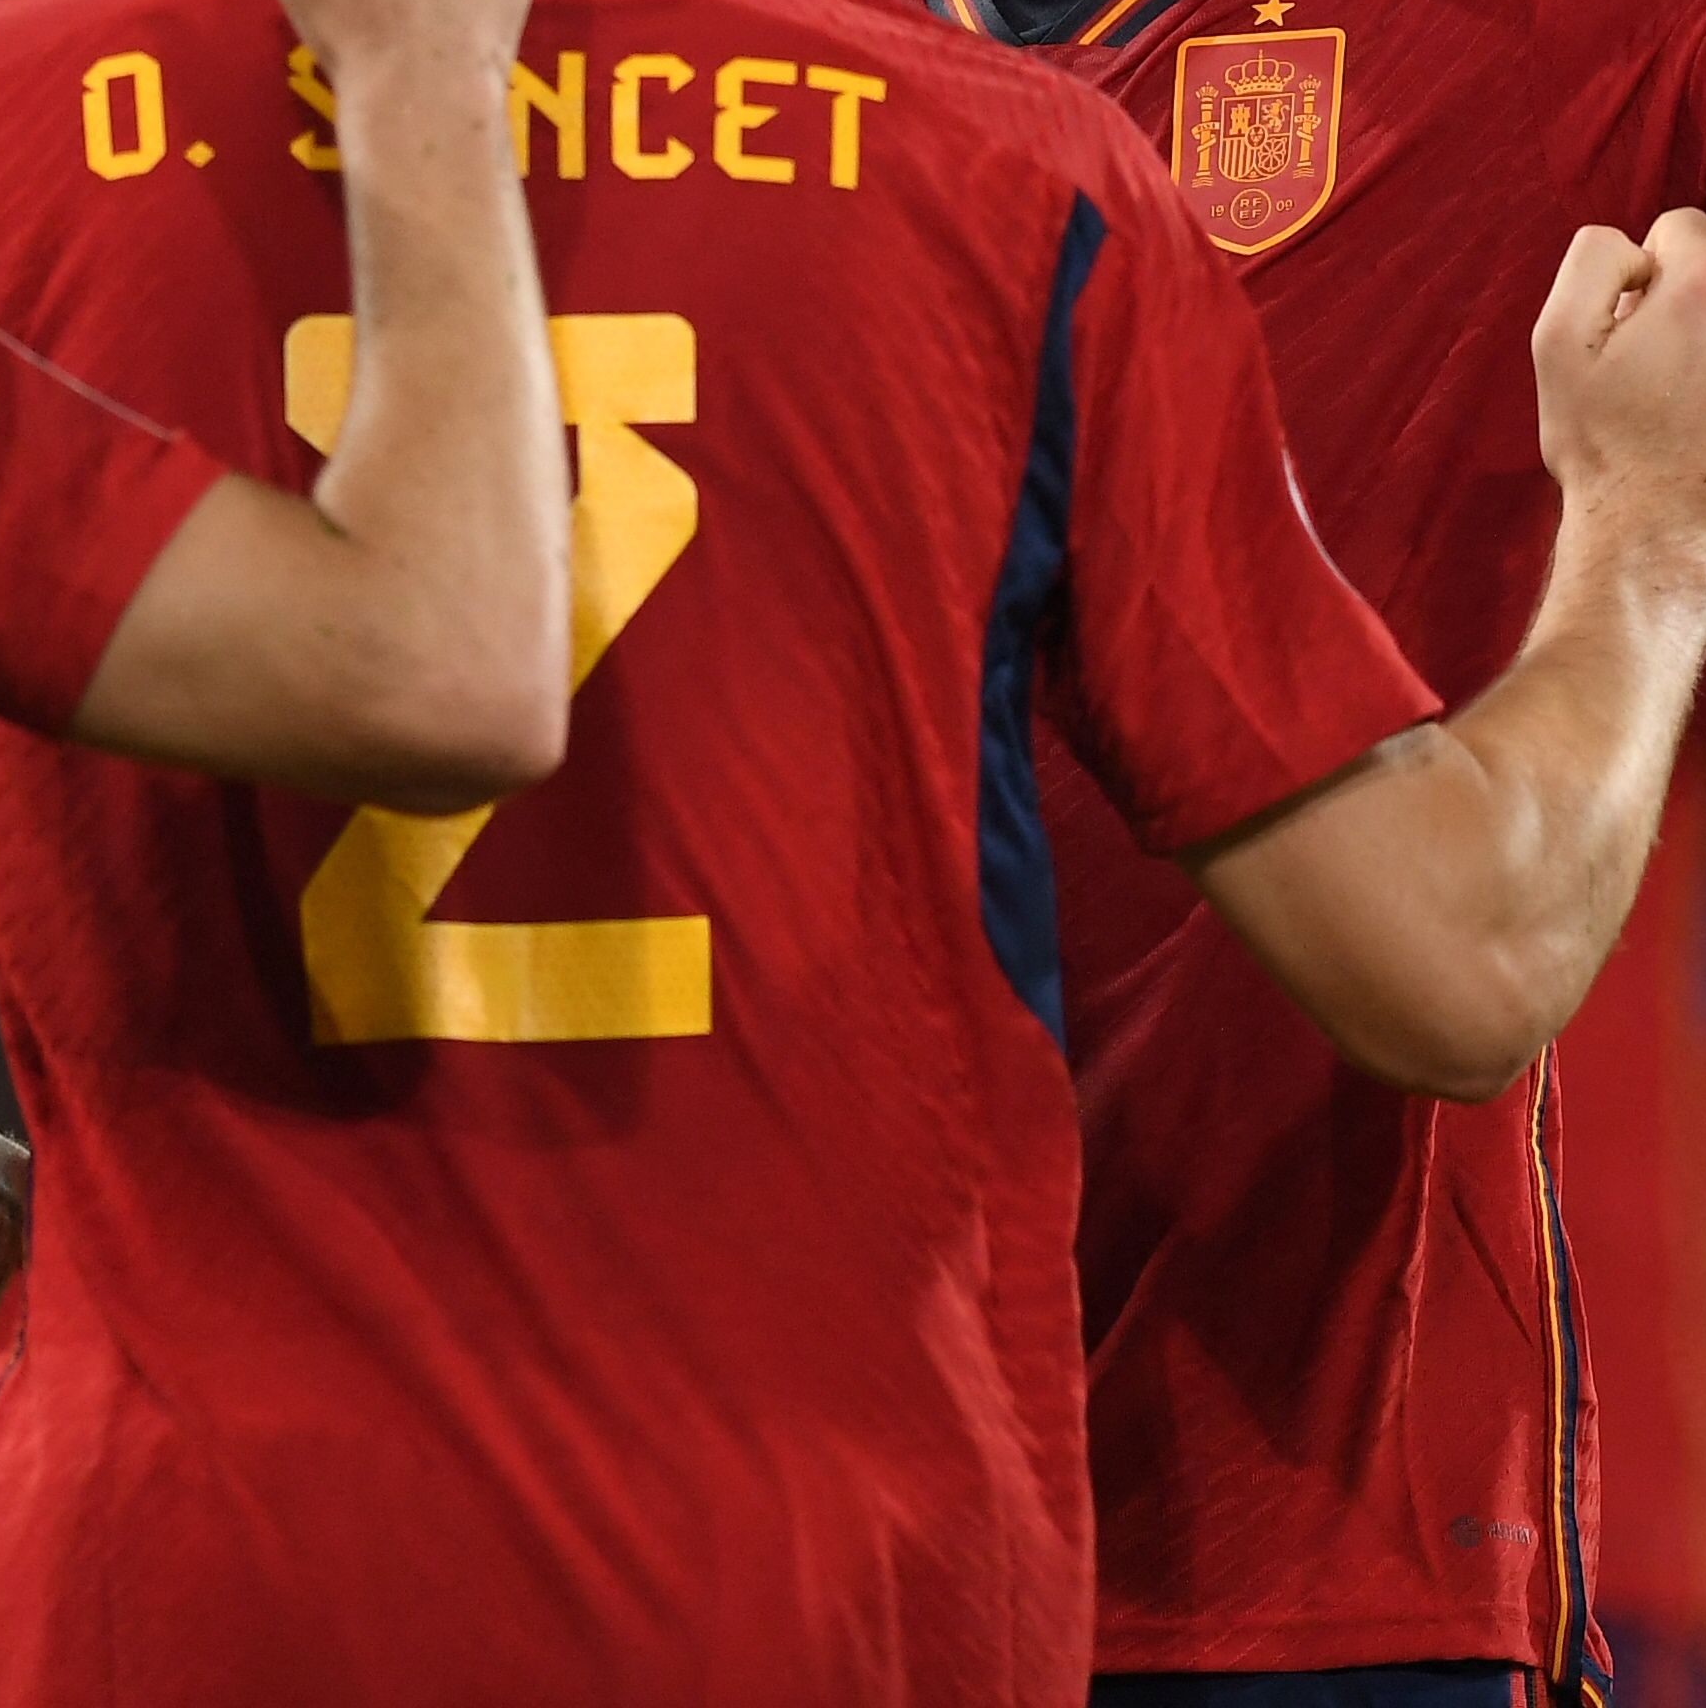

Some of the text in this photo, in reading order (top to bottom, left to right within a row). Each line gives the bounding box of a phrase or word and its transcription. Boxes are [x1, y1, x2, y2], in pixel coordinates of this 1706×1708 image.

[81, 44, 887, 190] O. SNCET
[284, 312, 713, 1044] 2
